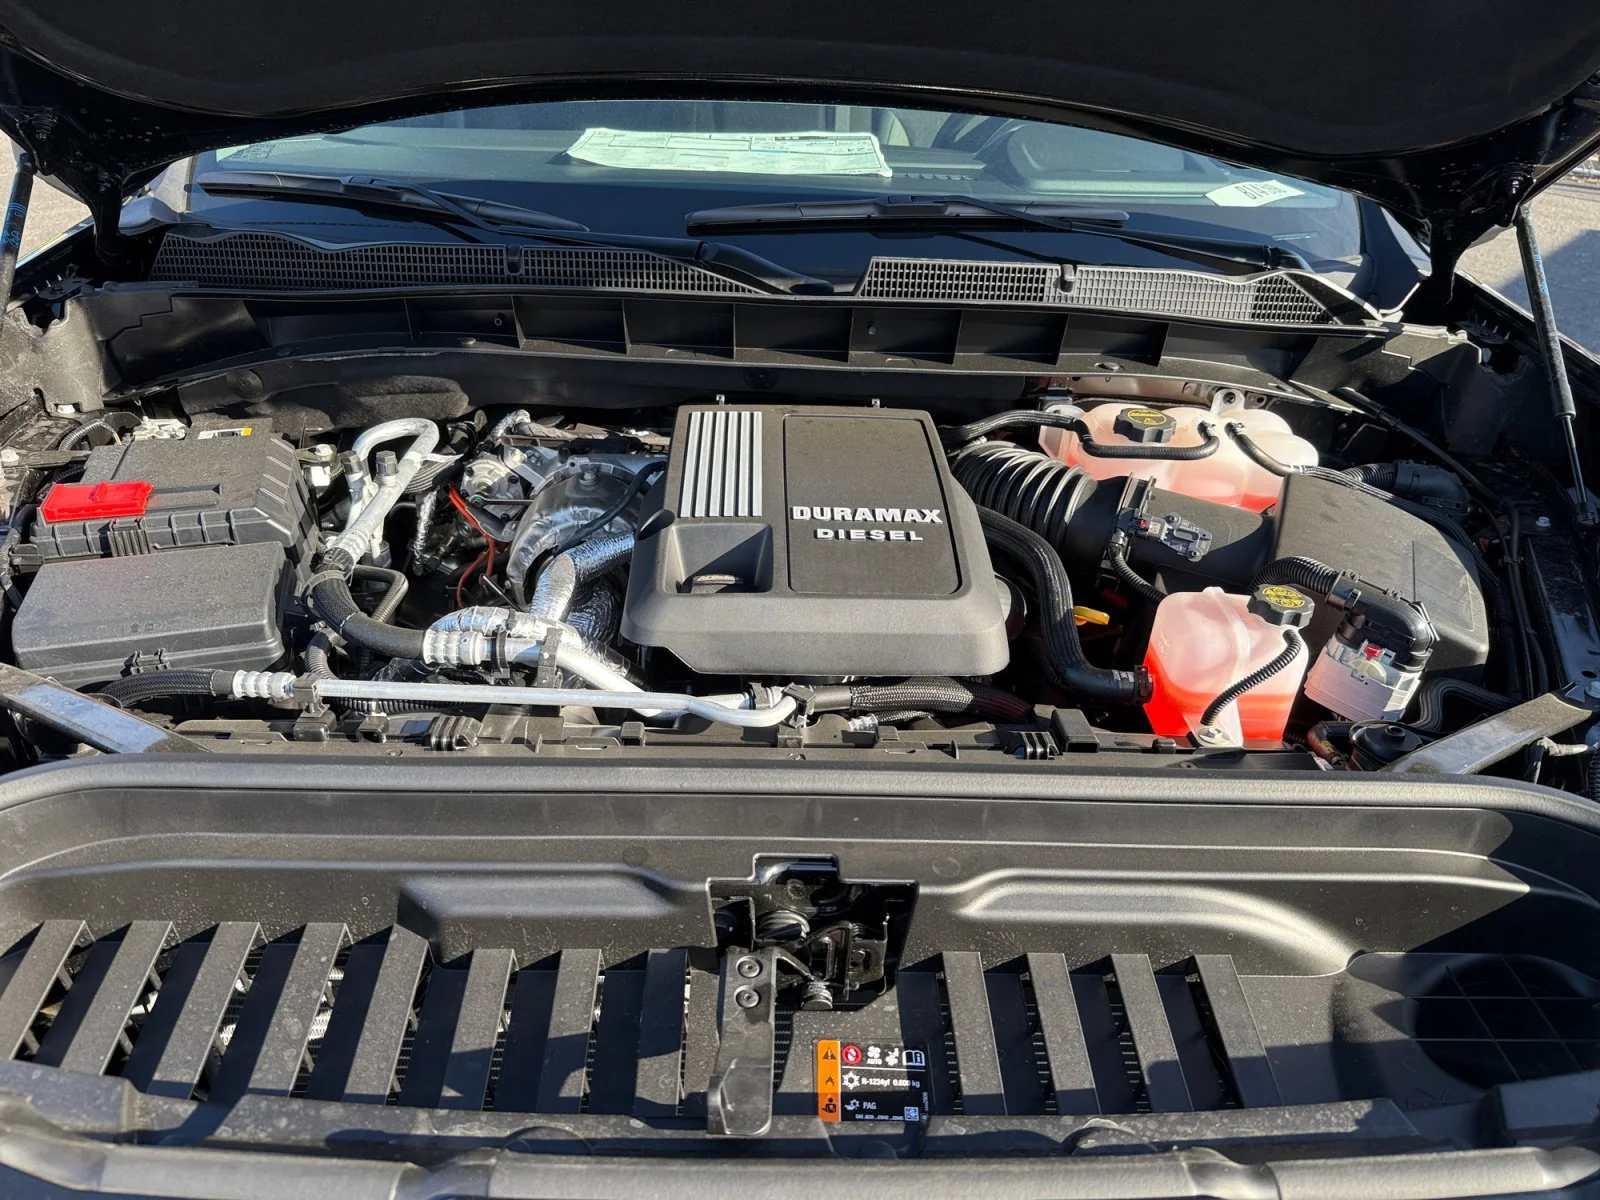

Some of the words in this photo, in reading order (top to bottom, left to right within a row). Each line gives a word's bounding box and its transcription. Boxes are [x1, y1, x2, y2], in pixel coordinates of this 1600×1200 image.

[792, 506, 943, 523] DURAMAX
[816, 528, 924, 541] DIESEL
[911, 1080, 921, 1088] kg
[862, 1101, 877, 1110] PAG
